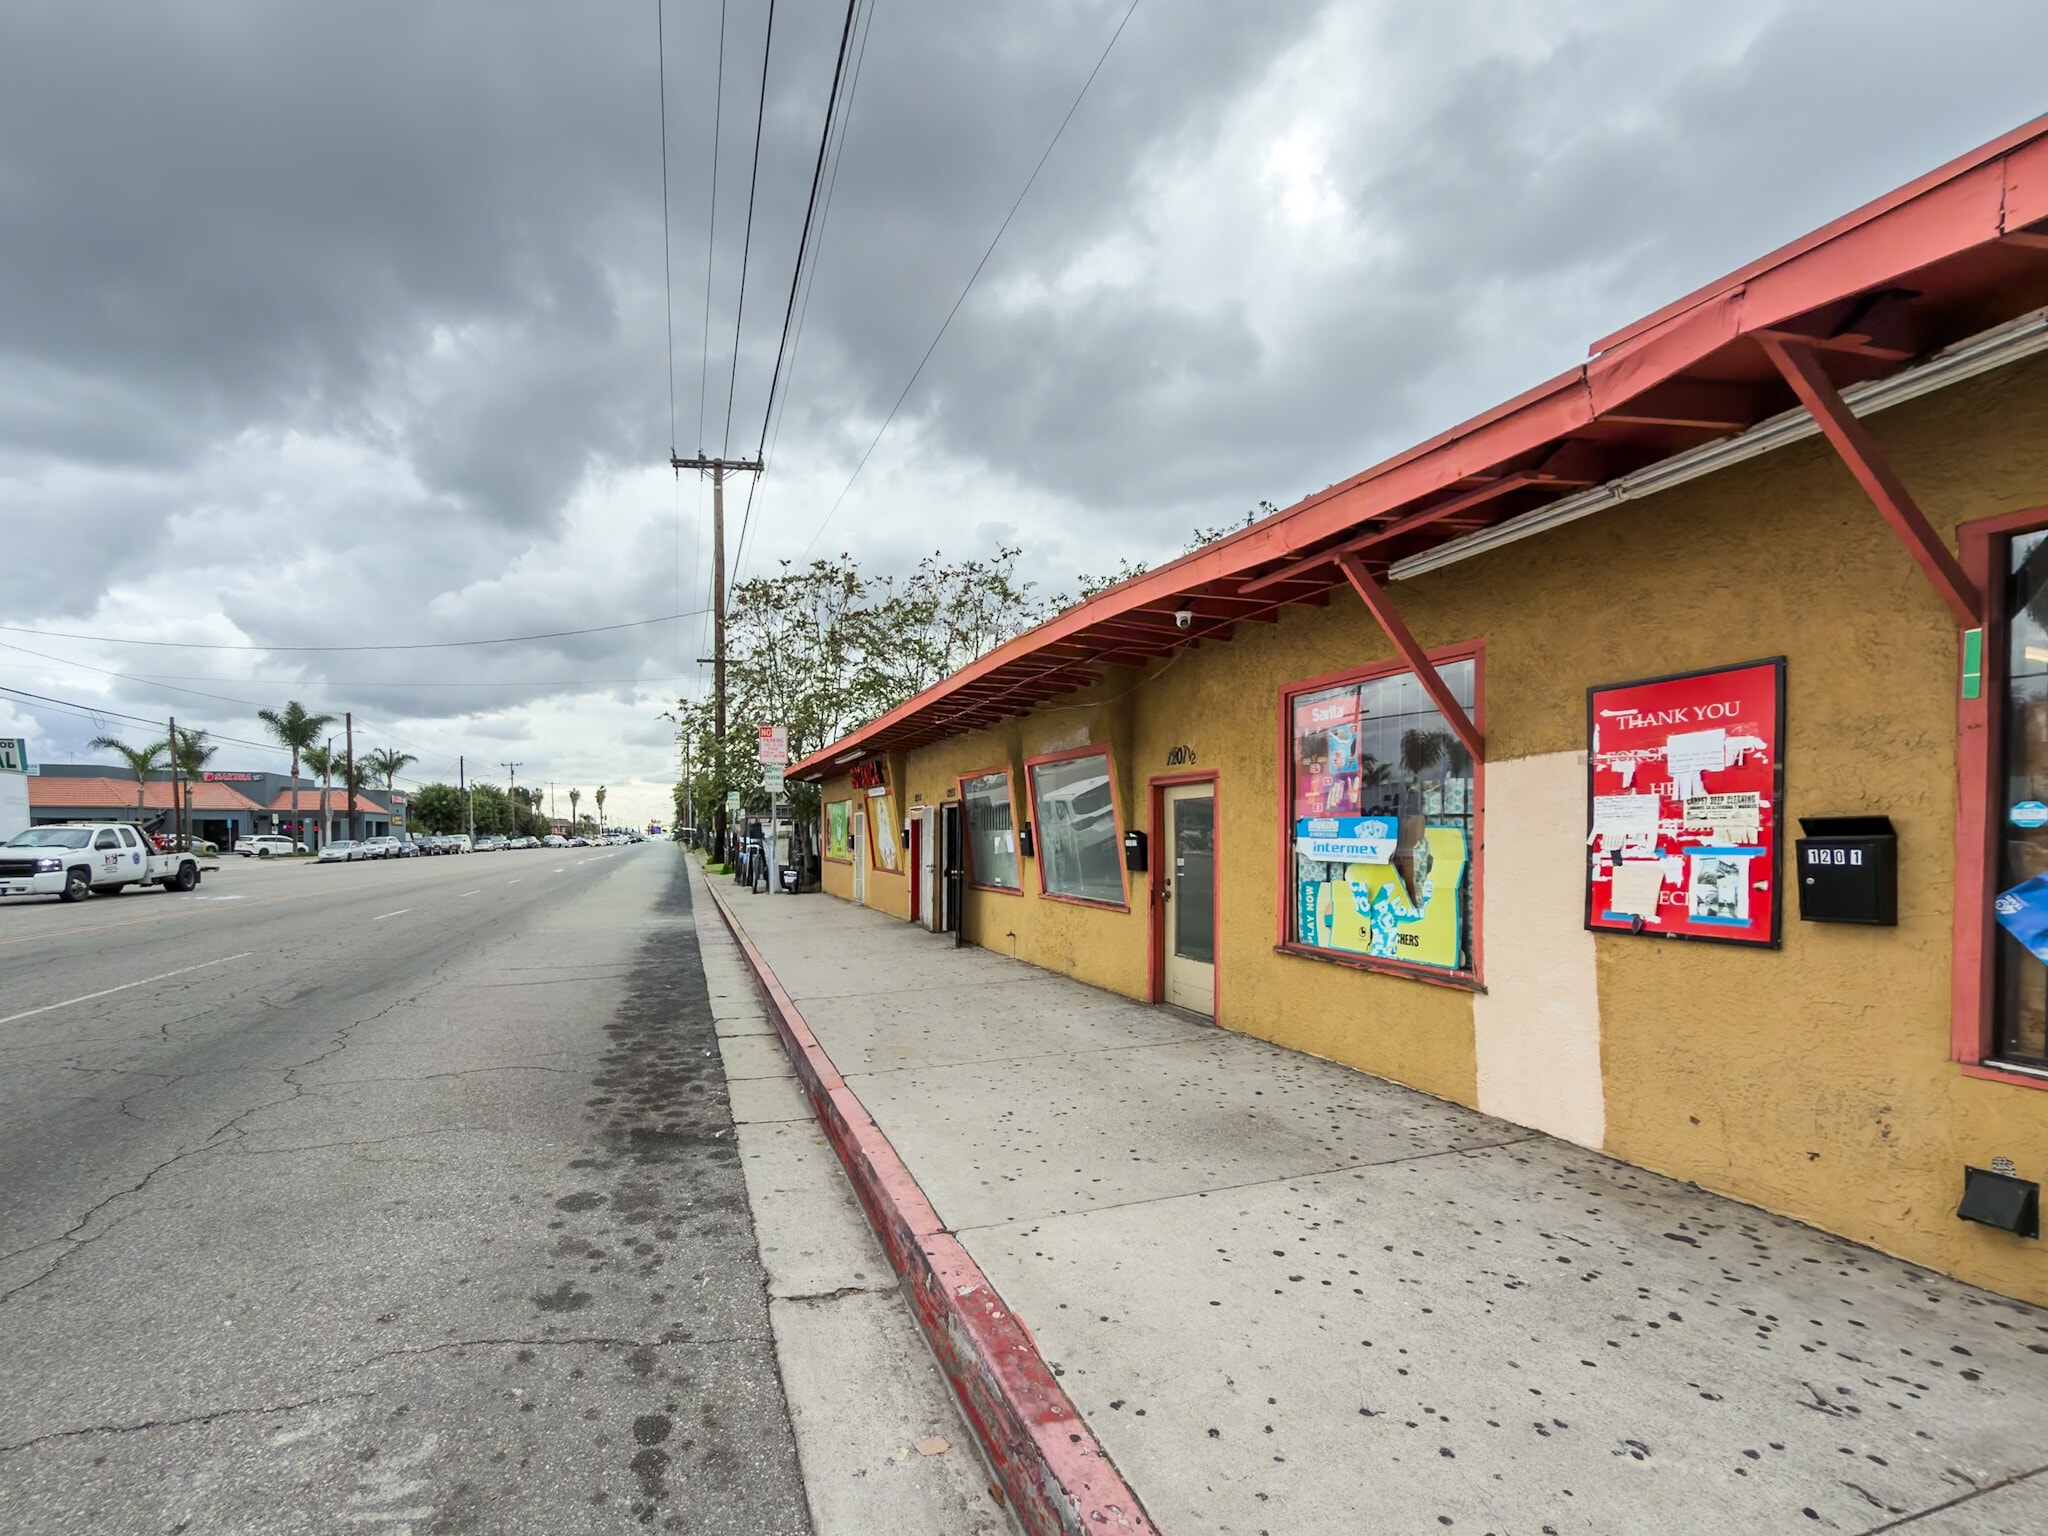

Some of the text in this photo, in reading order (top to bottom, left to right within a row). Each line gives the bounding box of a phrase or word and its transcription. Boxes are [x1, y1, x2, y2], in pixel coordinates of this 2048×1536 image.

[1312, 705, 1344, 722] Sarita
[1616, 701, 1741, 730] THANK YOU
[761, 728, 771, 736] NO
[1313, 841, 1379, 855] intermex
[1809, 850, 1861, 864] 1201
[1305, 886, 1315, 943] PLAY NOW
